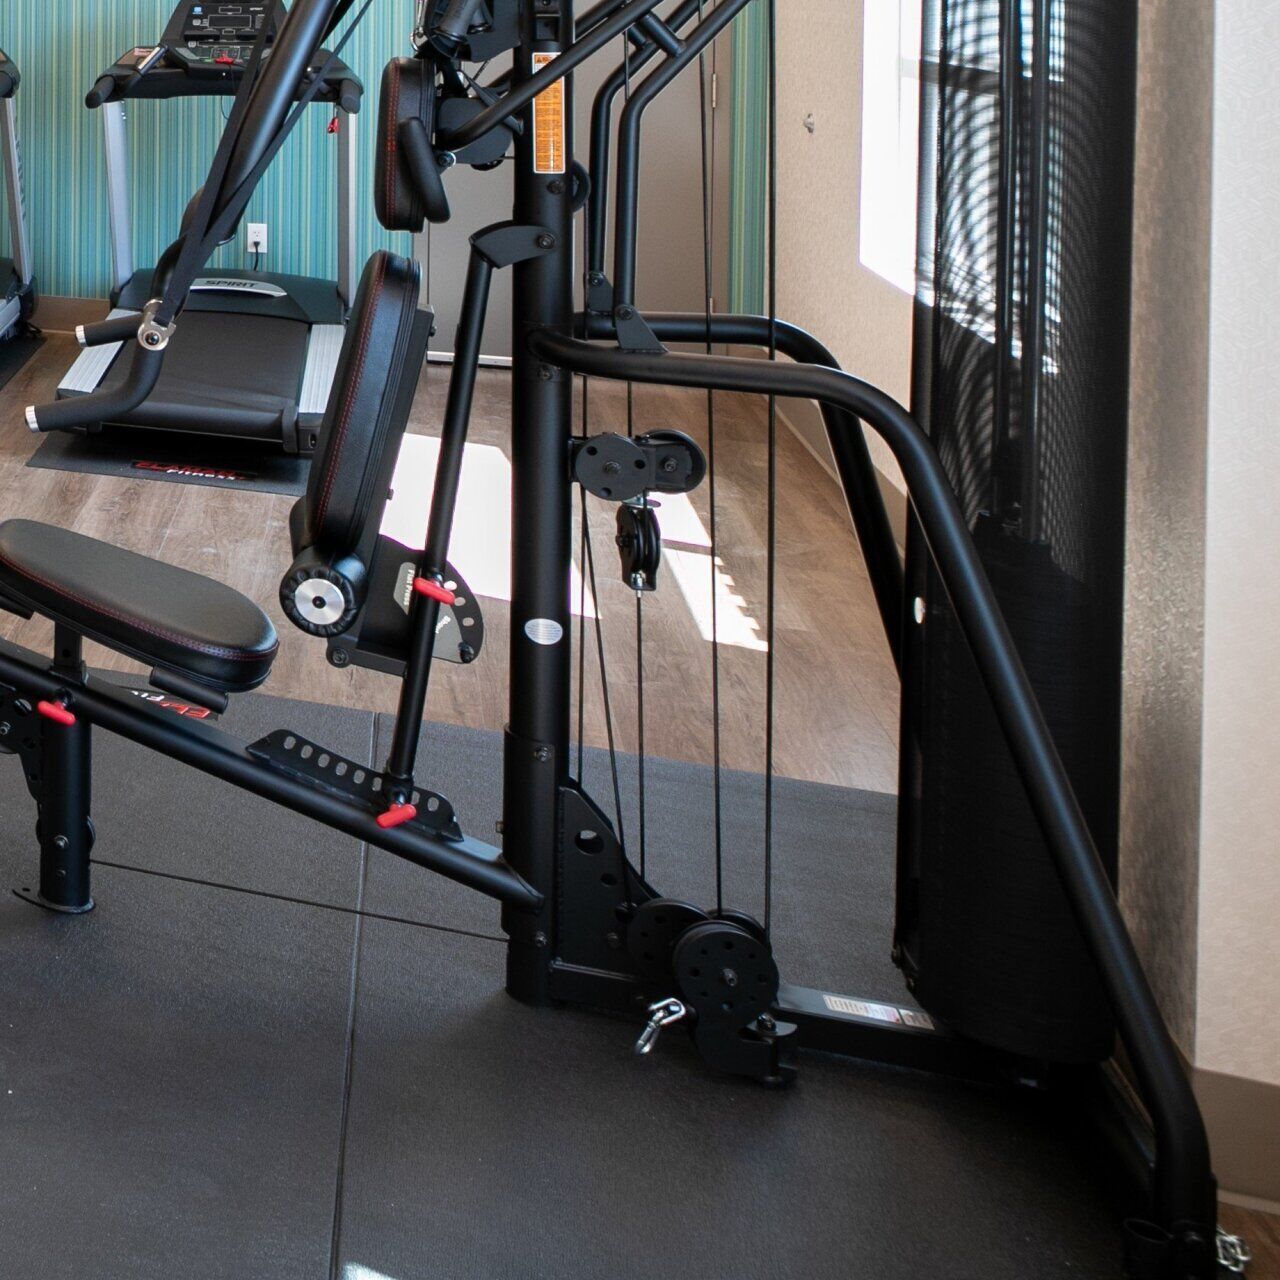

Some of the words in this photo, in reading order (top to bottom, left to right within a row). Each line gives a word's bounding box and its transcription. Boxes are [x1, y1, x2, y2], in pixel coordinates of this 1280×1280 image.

[203, 279, 259, 289] SPIRIT
[406, 569, 415, 584] Flat
[403, 584, 413, 606] Press
